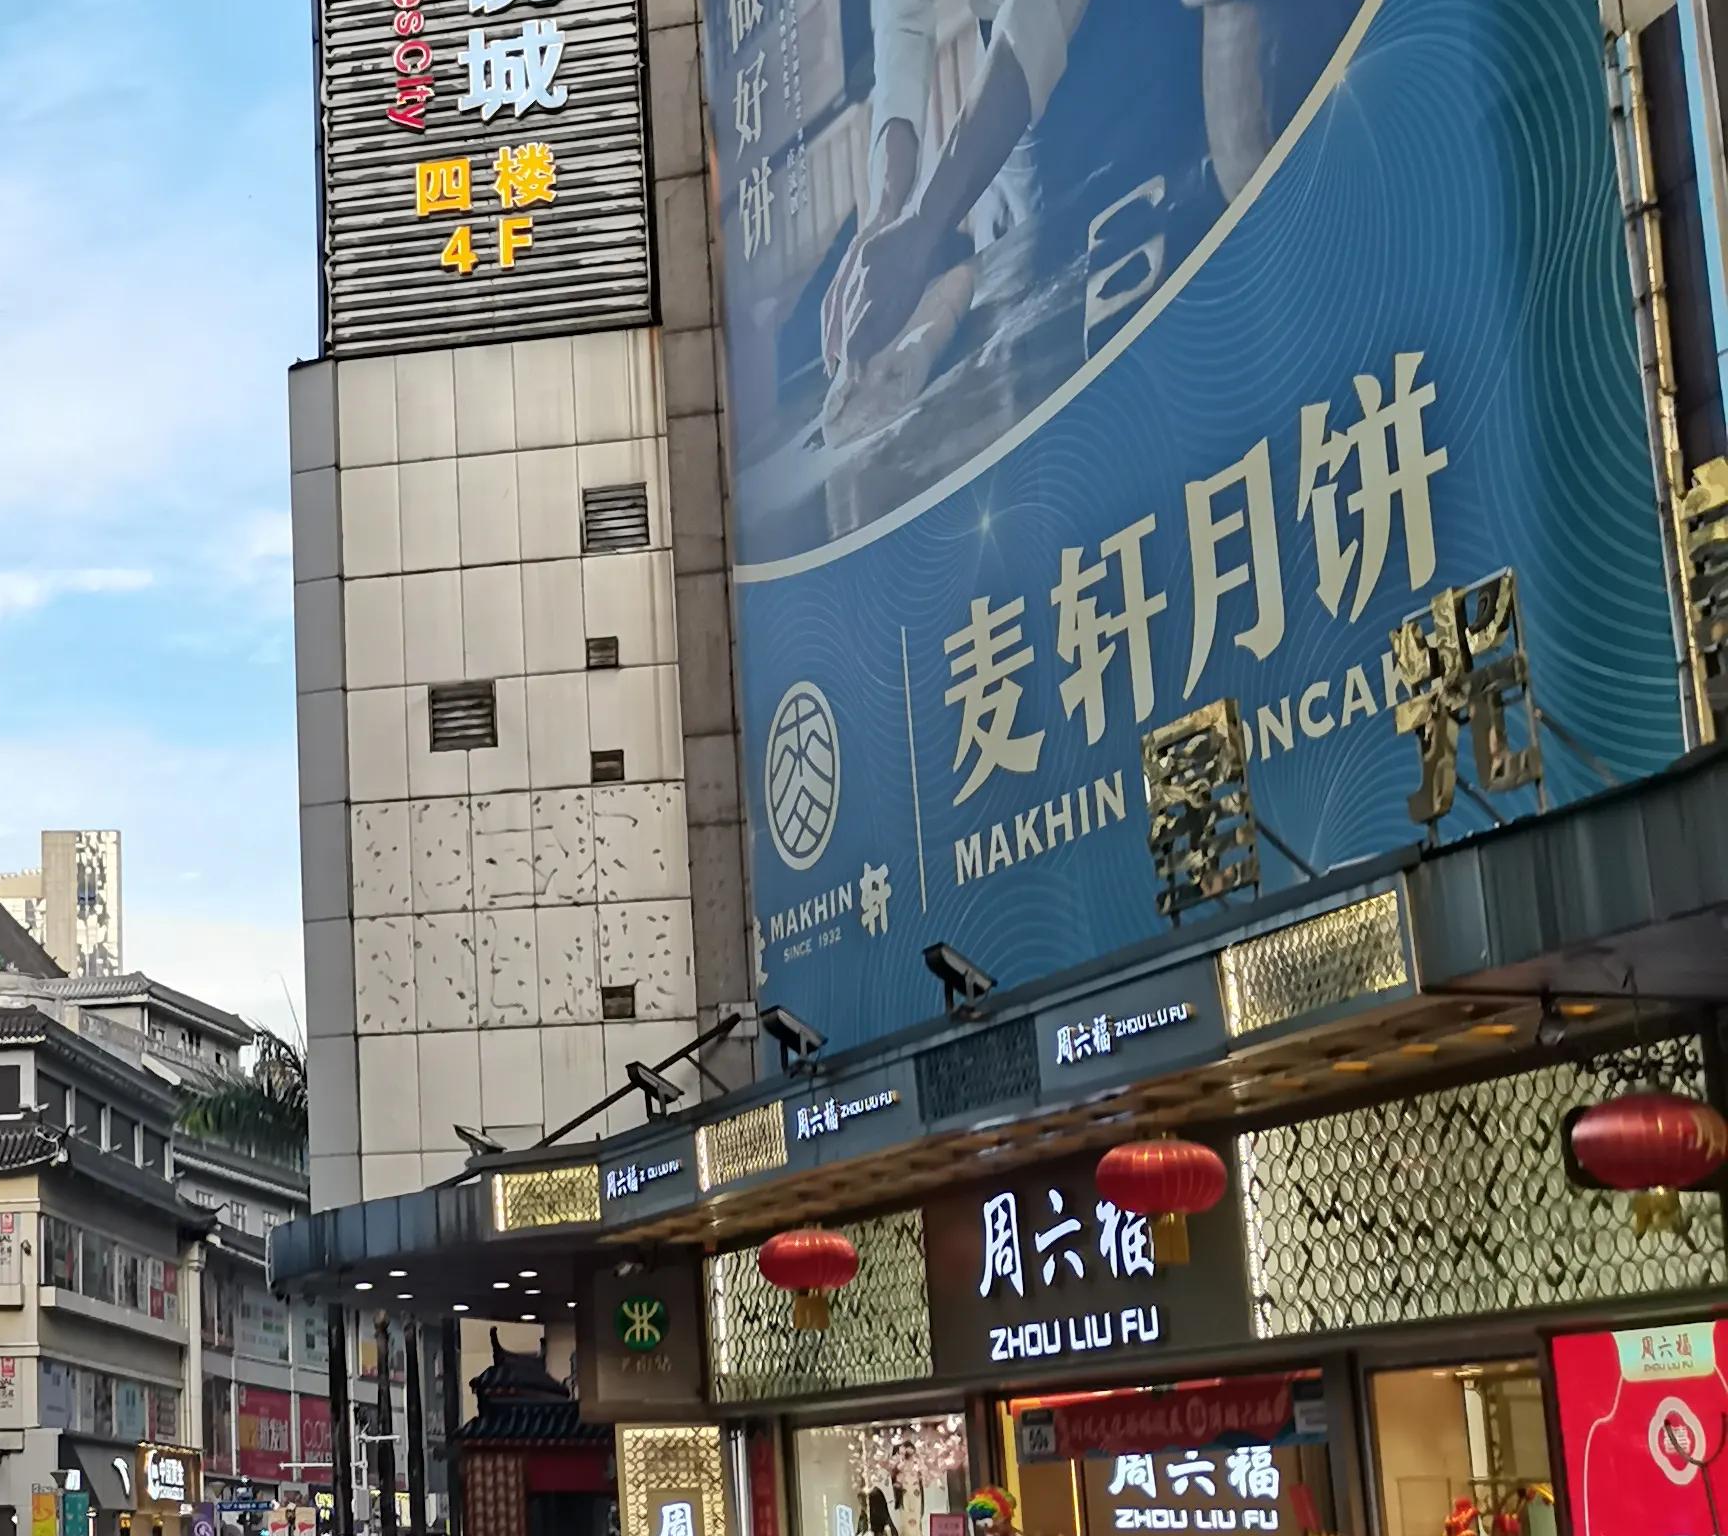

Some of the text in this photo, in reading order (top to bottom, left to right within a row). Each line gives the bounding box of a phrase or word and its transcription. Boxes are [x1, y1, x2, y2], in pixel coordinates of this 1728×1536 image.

[415, 143, 559, 221] 四楼
[440, 217, 535, 276] 4F
[942, 349, 1450, 809] 麦轩月饼
[954, 768, 1130, 887] MAKHIN
[771, 880, 853, 944] MAKHIN
[783, 925, 842, 964] SINCE 1932
[1056, 1014, 1112, 1067] 周六福
[1114, 1003, 1189, 1039] ZHOU LIU FU
[797, 1097, 840, 1142] 周六福
[989, 1305, 1160, 1362] ZHOU LIU FU
[1109, 1444, 1281, 1500] 周六福
[1115, 1508, 1280, 1531] ZHOU LIU FU
